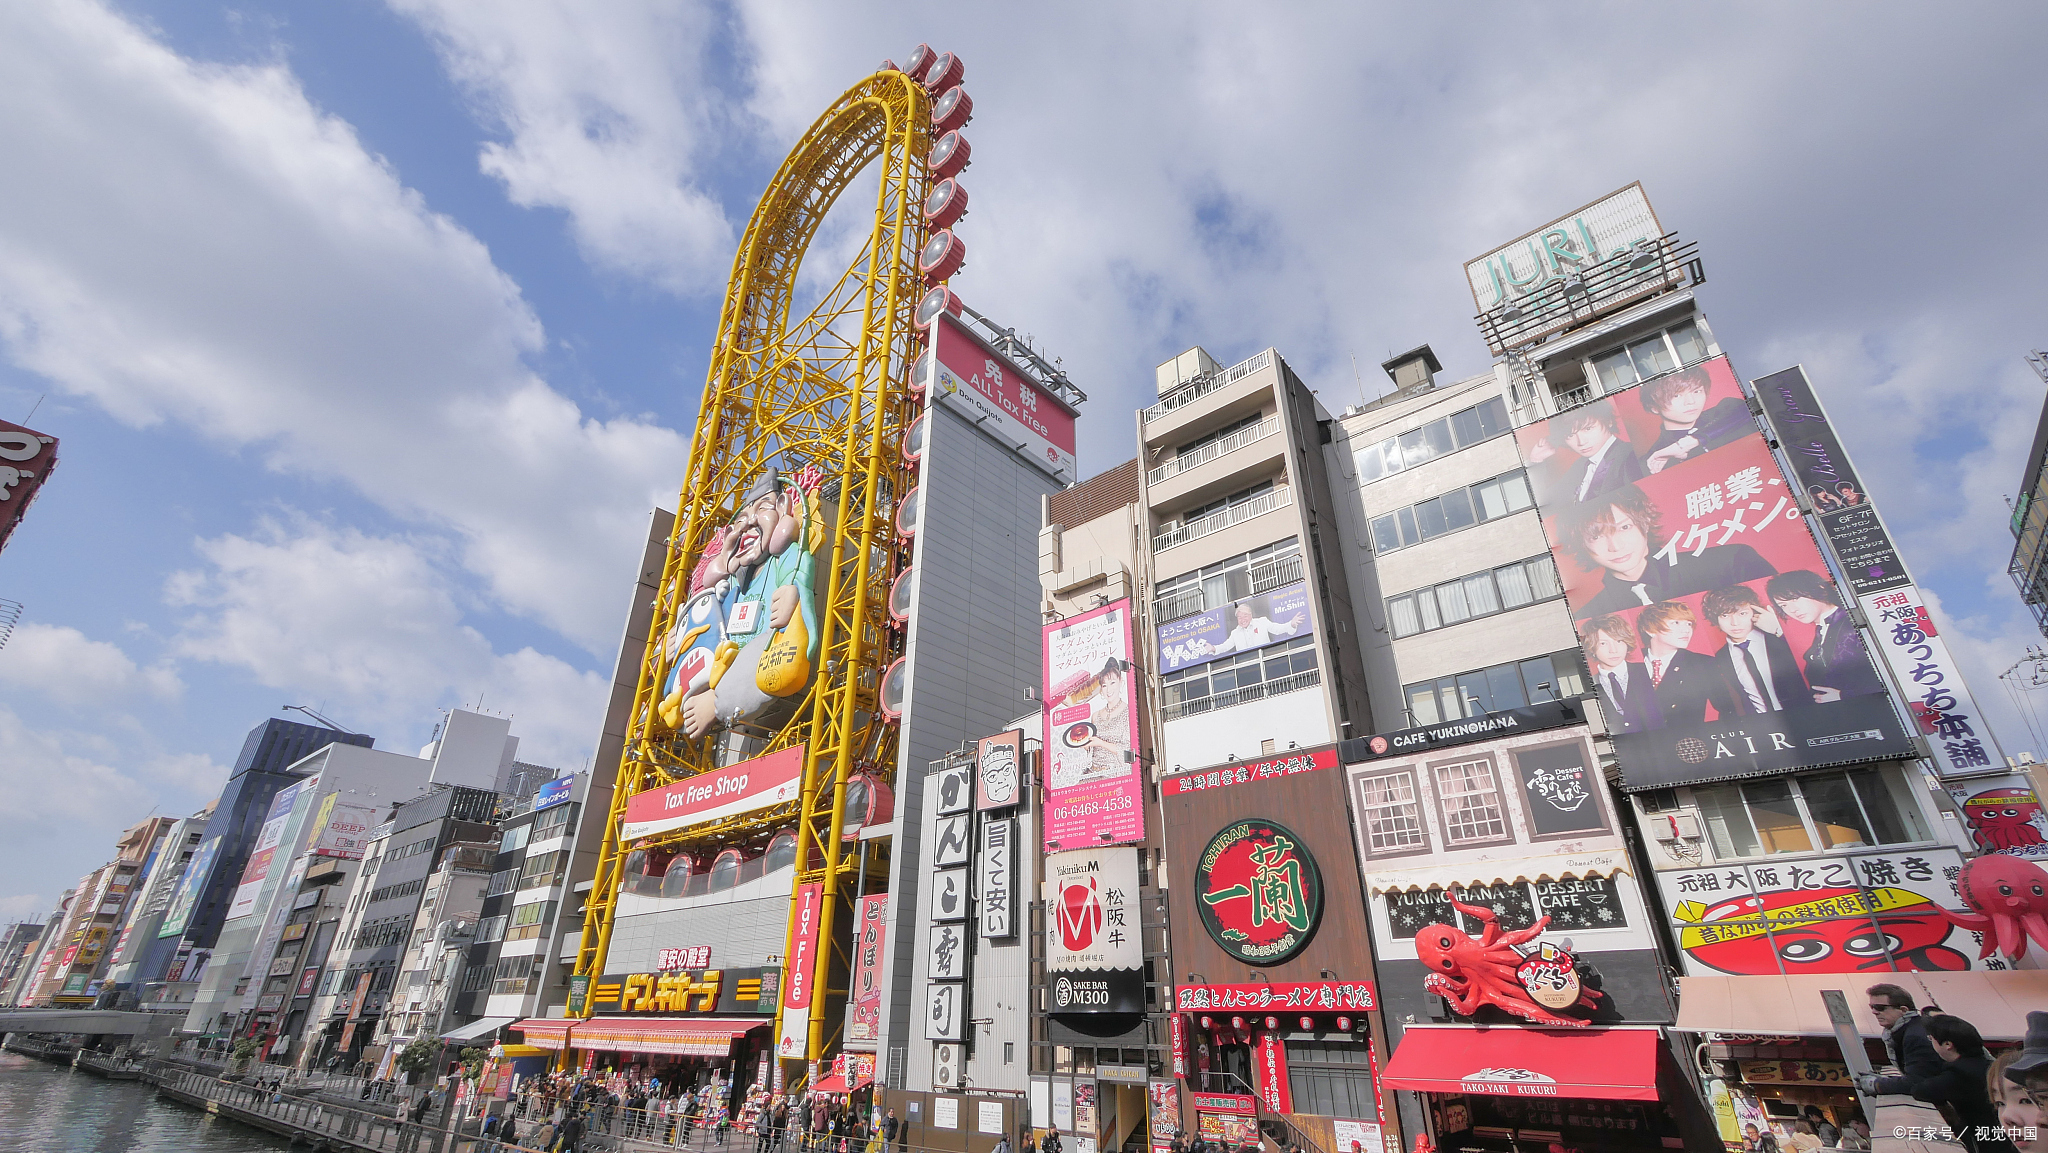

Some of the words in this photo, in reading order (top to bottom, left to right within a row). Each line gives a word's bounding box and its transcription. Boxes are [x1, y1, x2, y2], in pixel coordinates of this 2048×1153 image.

[1487, 218, 1596, 307] JURI
[959, 388, 974, 405] Don
[976, 401, 1003, 424] Quijote
[970, 373, 994, 398] ALL
[998, 392, 1020, 417] Tax
[1023, 410, 1048, 437] Free
[1685, 465, 1781, 520] 職業、
[1652, 496, 1800, 567] イケメン。
[1833, 520, 1870, 532] セットサロン
[1849, 536, 1868, 544] エステ
[1850, 556, 1890, 569] こちらまで
[1274, 601, 1306, 615] Mr.Shin
[1872, 592, 1910, 610] 元祖
[1880, 605, 1917, 623] 大阪
[1056, 627, 1116, 651] マダムシンコ
[1163, 632, 1190, 645] Welcome
[1198, 622, 1221, 635] OSAKA
[1056, 647, 1117, 670] マダムブリュレ
[1393, 732, 1426, 747] CAFE
[1428, 716, 1518, 740] YUKINOHANA
[1710, 730, 1745, 740] CLUB
[1714, 732, 1796, 759] AIR
[1555, 766, 1584, 775] Dessert
[1556, 773, 1574, 782] Cafe
[664, 792, 684, 811] Tax
[686, 785, 712, 805] Free
[715, 773, 749, 797] Shop
[1948, 783, 1965, 791] 元祖
[1951, 790, 1968, 798] 大阪
[1054, 795, 1133, 820] 06-6468-4538
[331, 822, 366, 832] DEEP
[1202, 824, 1250, 873] ICHIRAN
[985, 823, 1007, 932] 旨くて安い
[1203, 836, 1310, 932] 一蘭
[1536, 878, 1606, 896] DESSERT
[1539, 893, 1582, 908] CAFE
[799, 891, 813, 935] Tax
[1105, 887, 1127, 950] 松阪牛
[863, 900, 879, 992] とんぼり
[762, 972, 778, 992] 薬
[792, 941, 807, 1001] Free
[571, 979, 587, 995] 薬
[1073, 981, 1092, 990] SAKE
[1092, 981, 1108, 990] BAR
[1179, 984, 1374, 1009] 天然とんこつラーメン専門店
[1072, 991, 1109, 1005] M300
[1460, 1083, 1509, 1094] TAKO-YAKI
[1517, 1085, 1557, 1095] KUKURU
